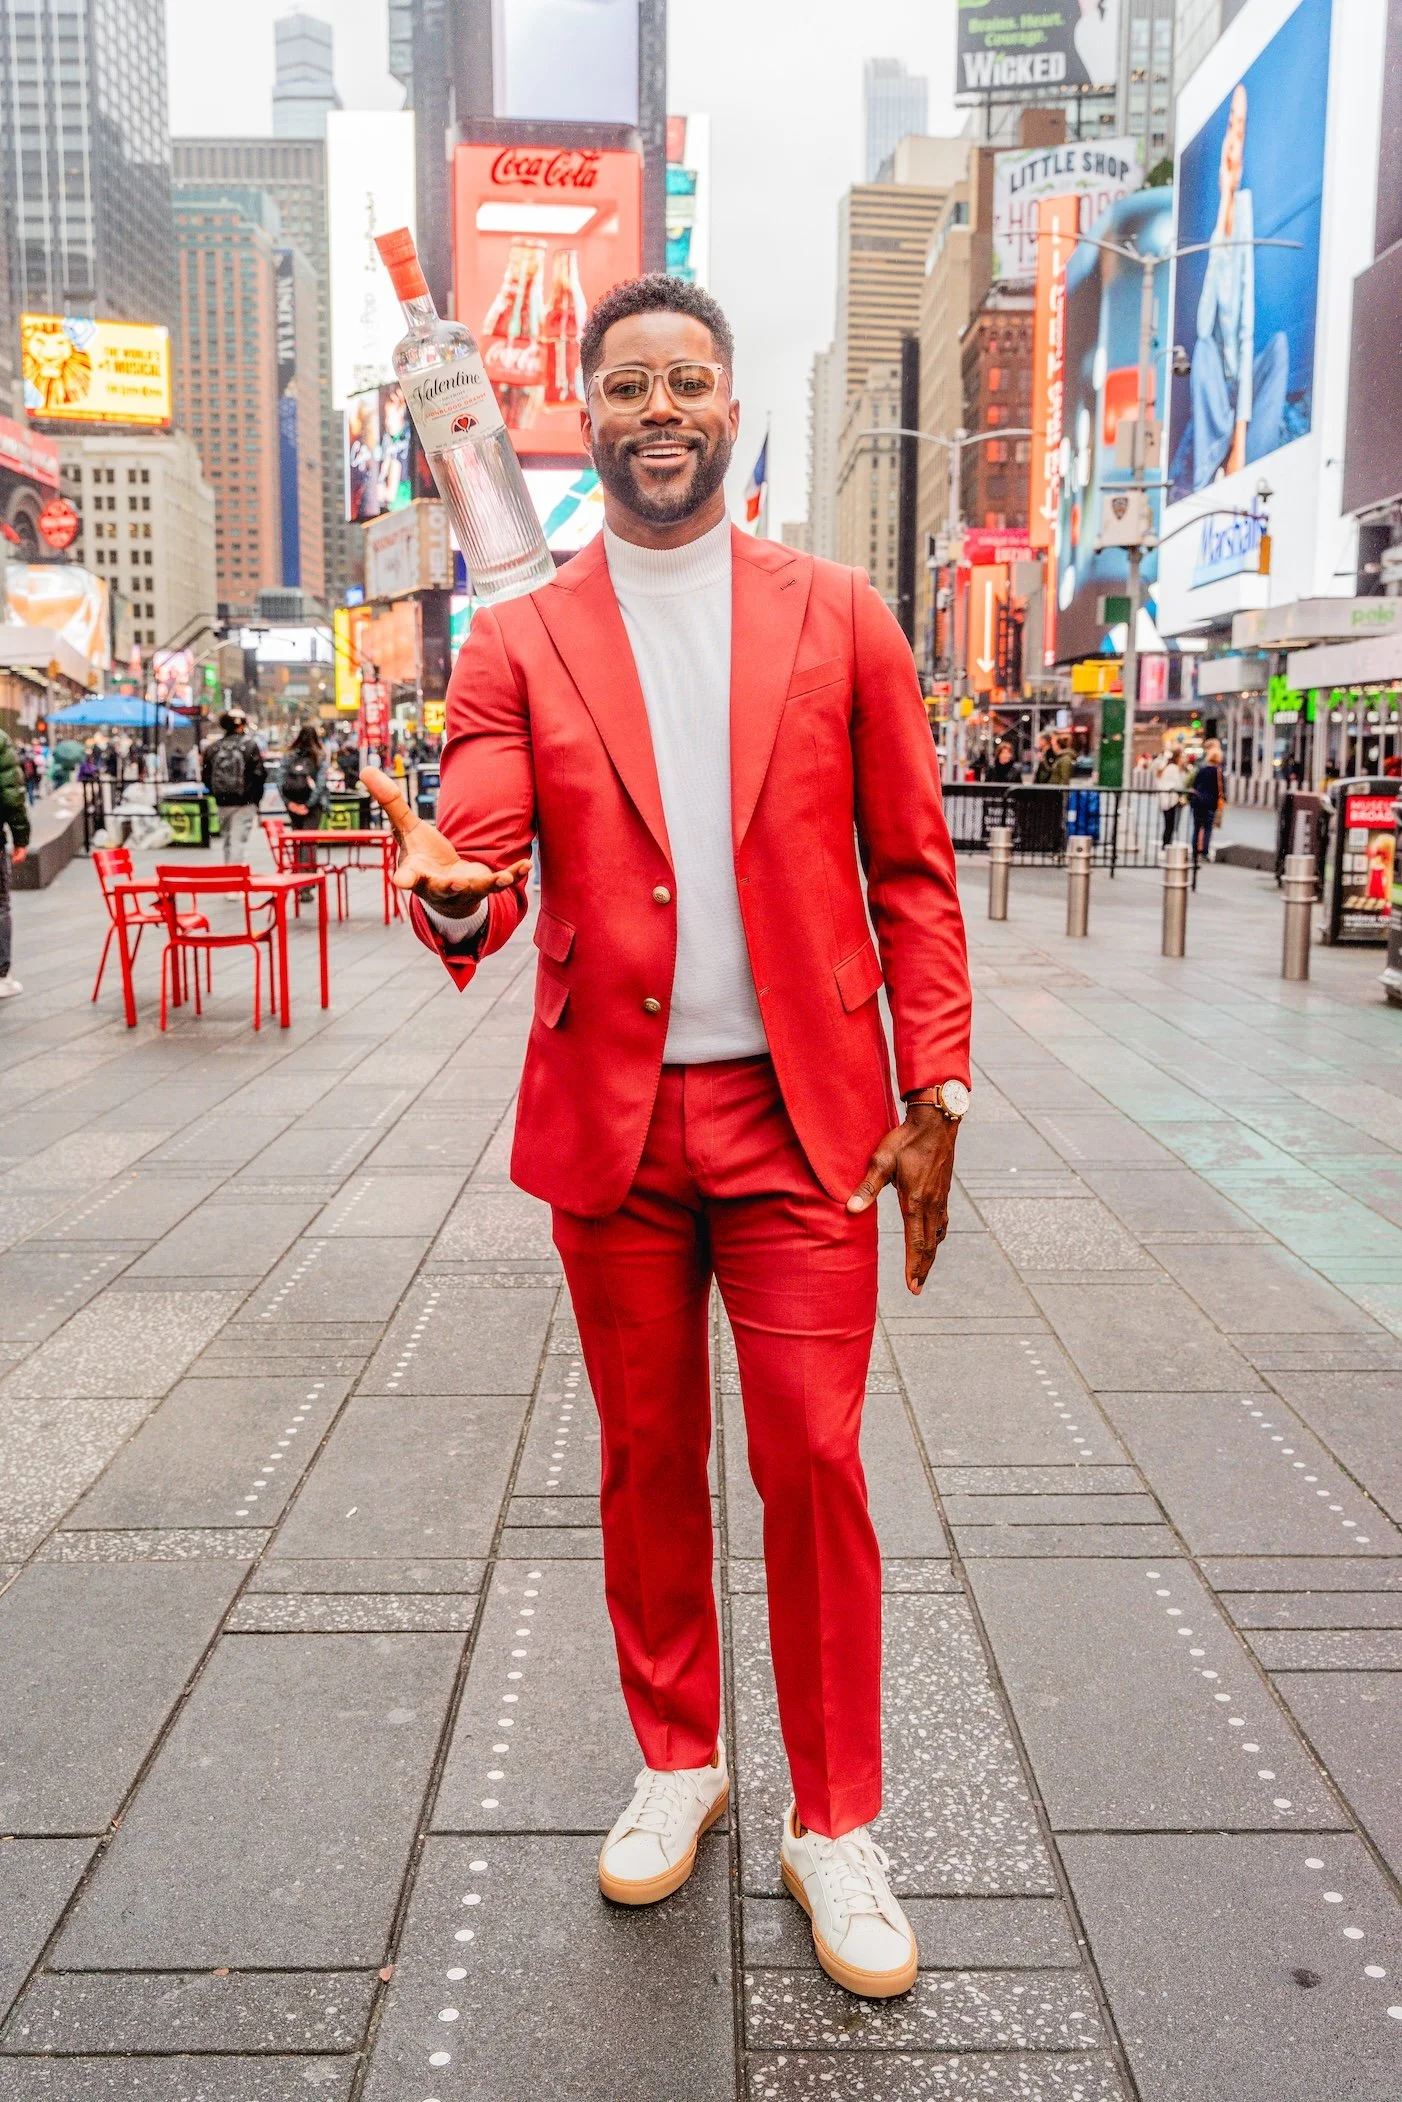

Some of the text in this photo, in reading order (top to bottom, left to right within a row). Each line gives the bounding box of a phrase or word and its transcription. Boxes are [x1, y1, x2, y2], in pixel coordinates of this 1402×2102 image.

[1010, 151, 1129, 195] LITTLE SHOP
[114, 362, 161, 376] MUSICAL
[412, 371, 481, 409] Valentine
